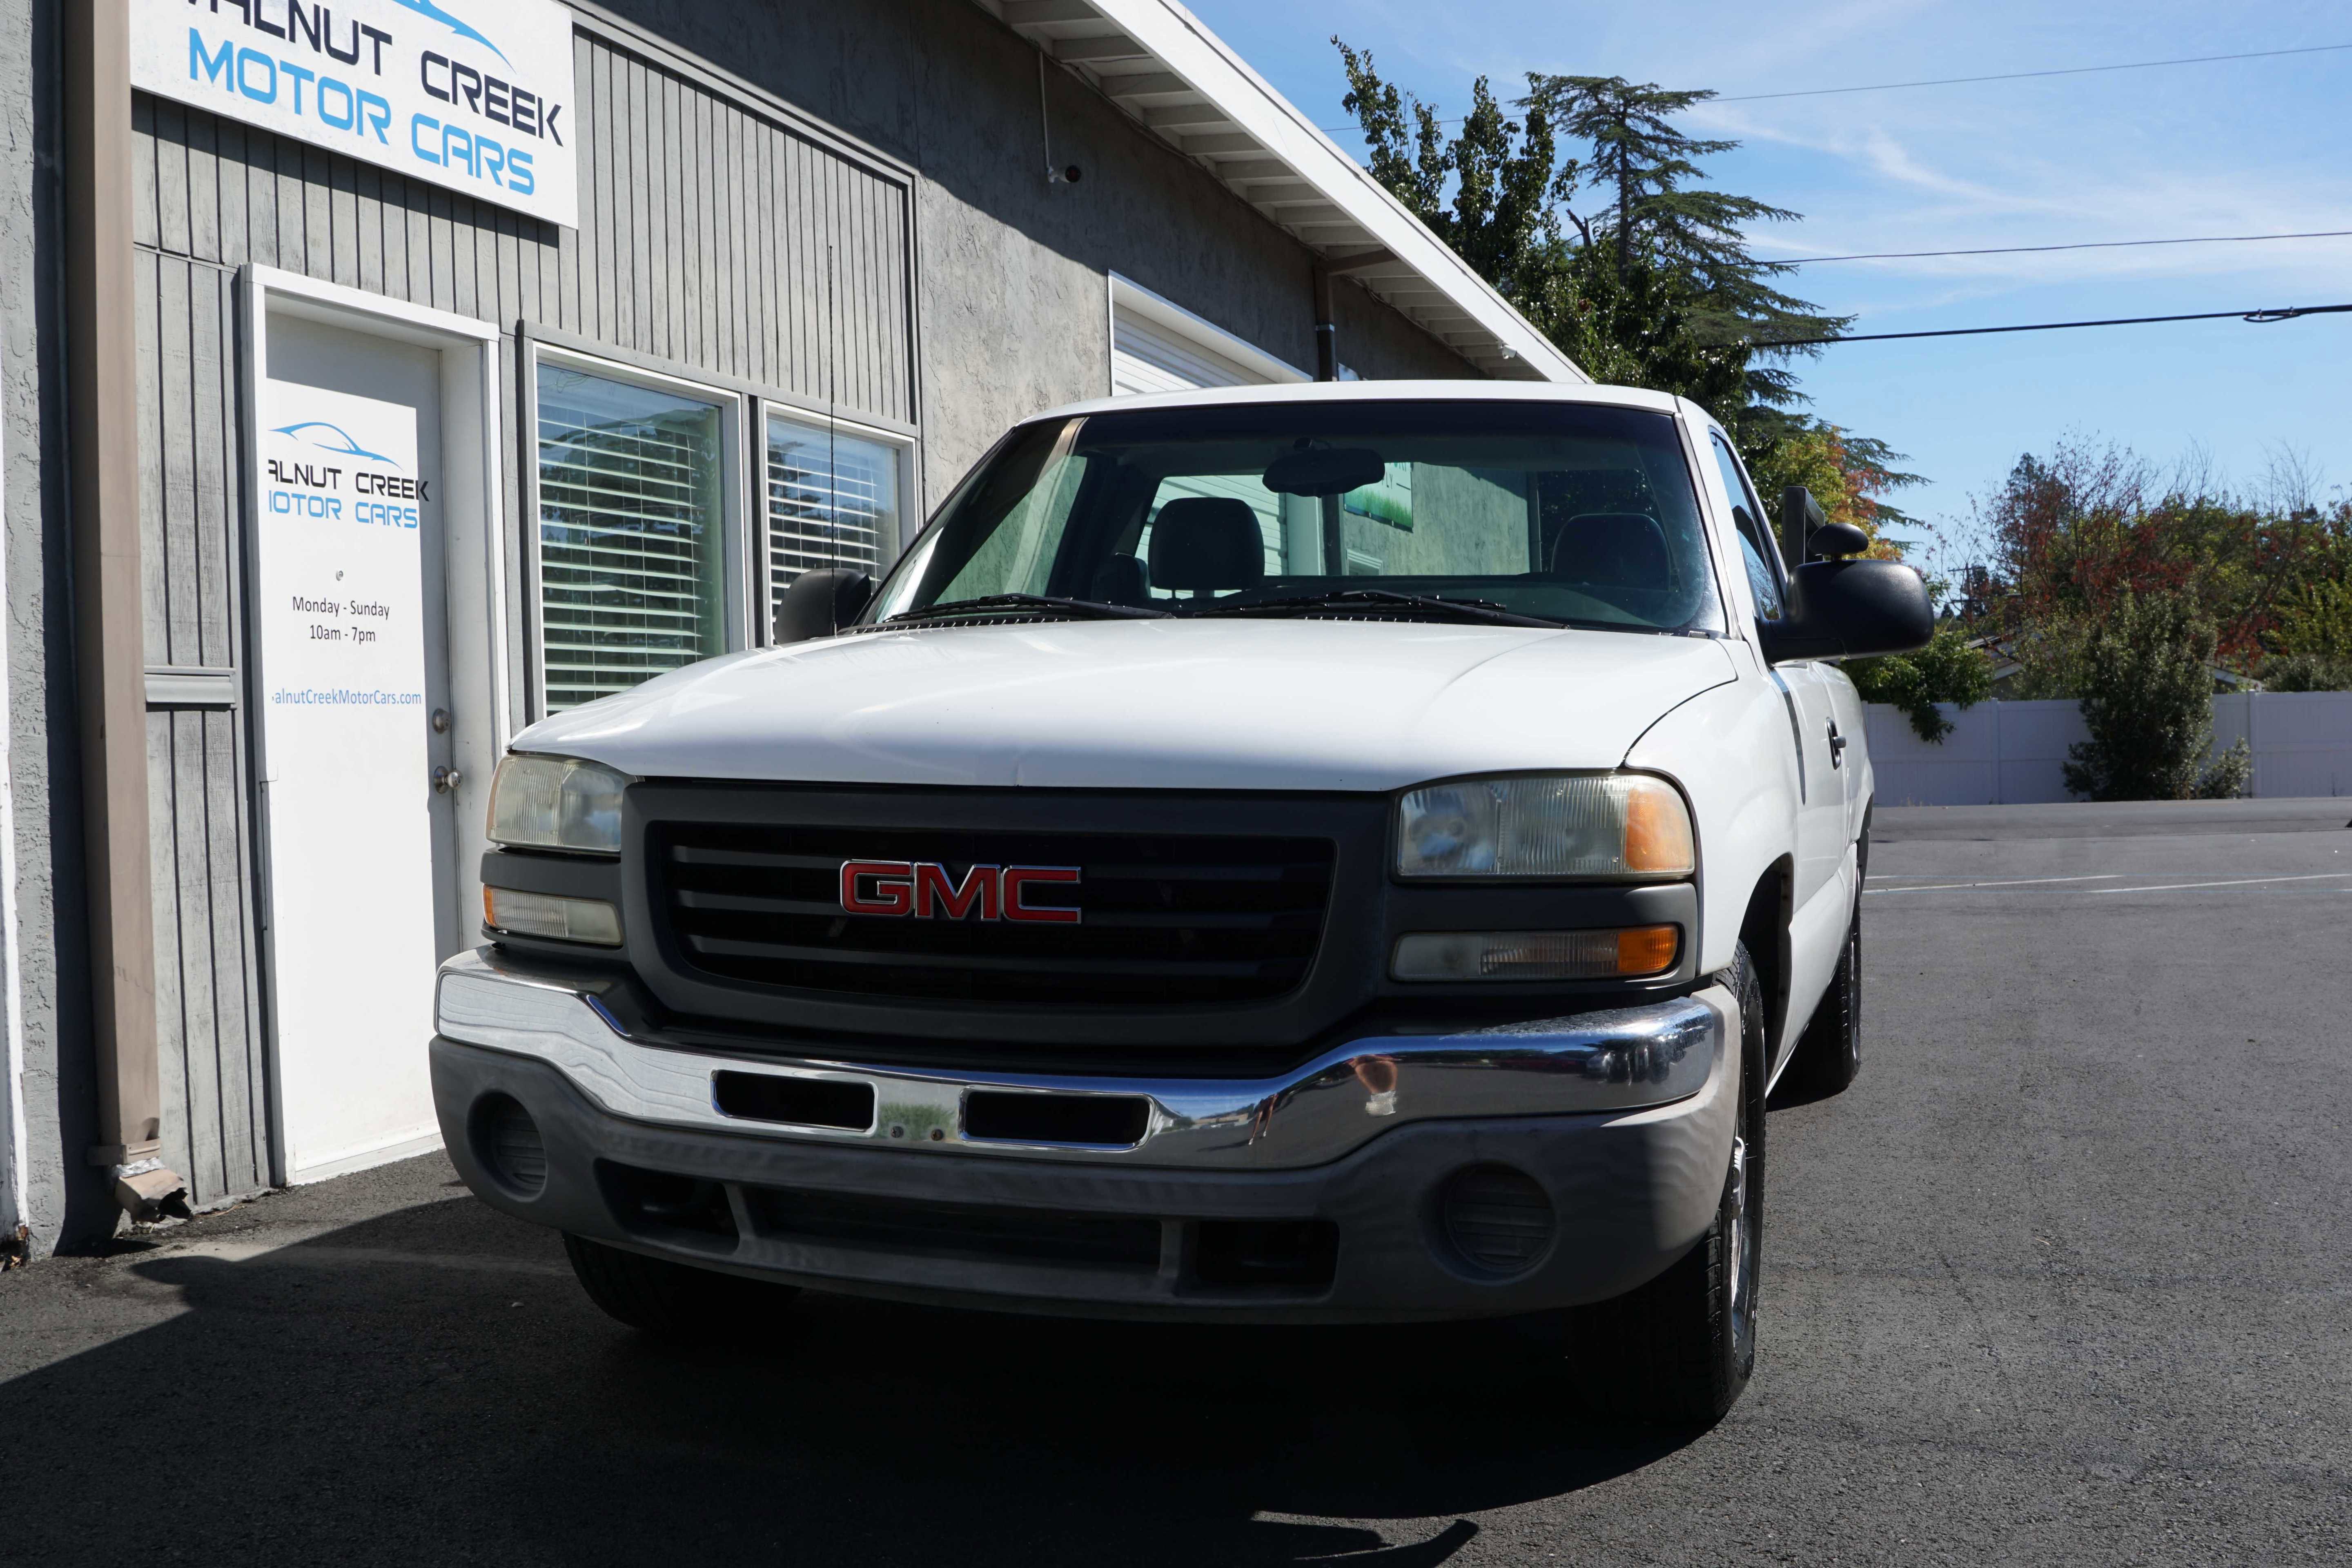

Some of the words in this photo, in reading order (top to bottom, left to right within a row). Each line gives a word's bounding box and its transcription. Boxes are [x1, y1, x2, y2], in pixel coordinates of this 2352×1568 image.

[188, 0, 392, 76] LNUT
[421, 50, 563, 147] CREEK
[189, 27, 392, 145] MOTOR
[411, 112, 535, 196] CARS
[268, 459, 342, 490] ALNUT
[355, 472, 430, 502] CREEK
[269, 490, 342, 520] OTOR
[355, 501, 418, 529] CARS
[292, 596, 340, 617] Monday
[350, 600, 390, 620] Sunday
[310, 625, 341, 640] 10am
[352, 627, 376, 645] 7pm
[272, 688, 421, 704] alnutCreekMotorCars.com
[840, 859, 1081, 924] GMC
